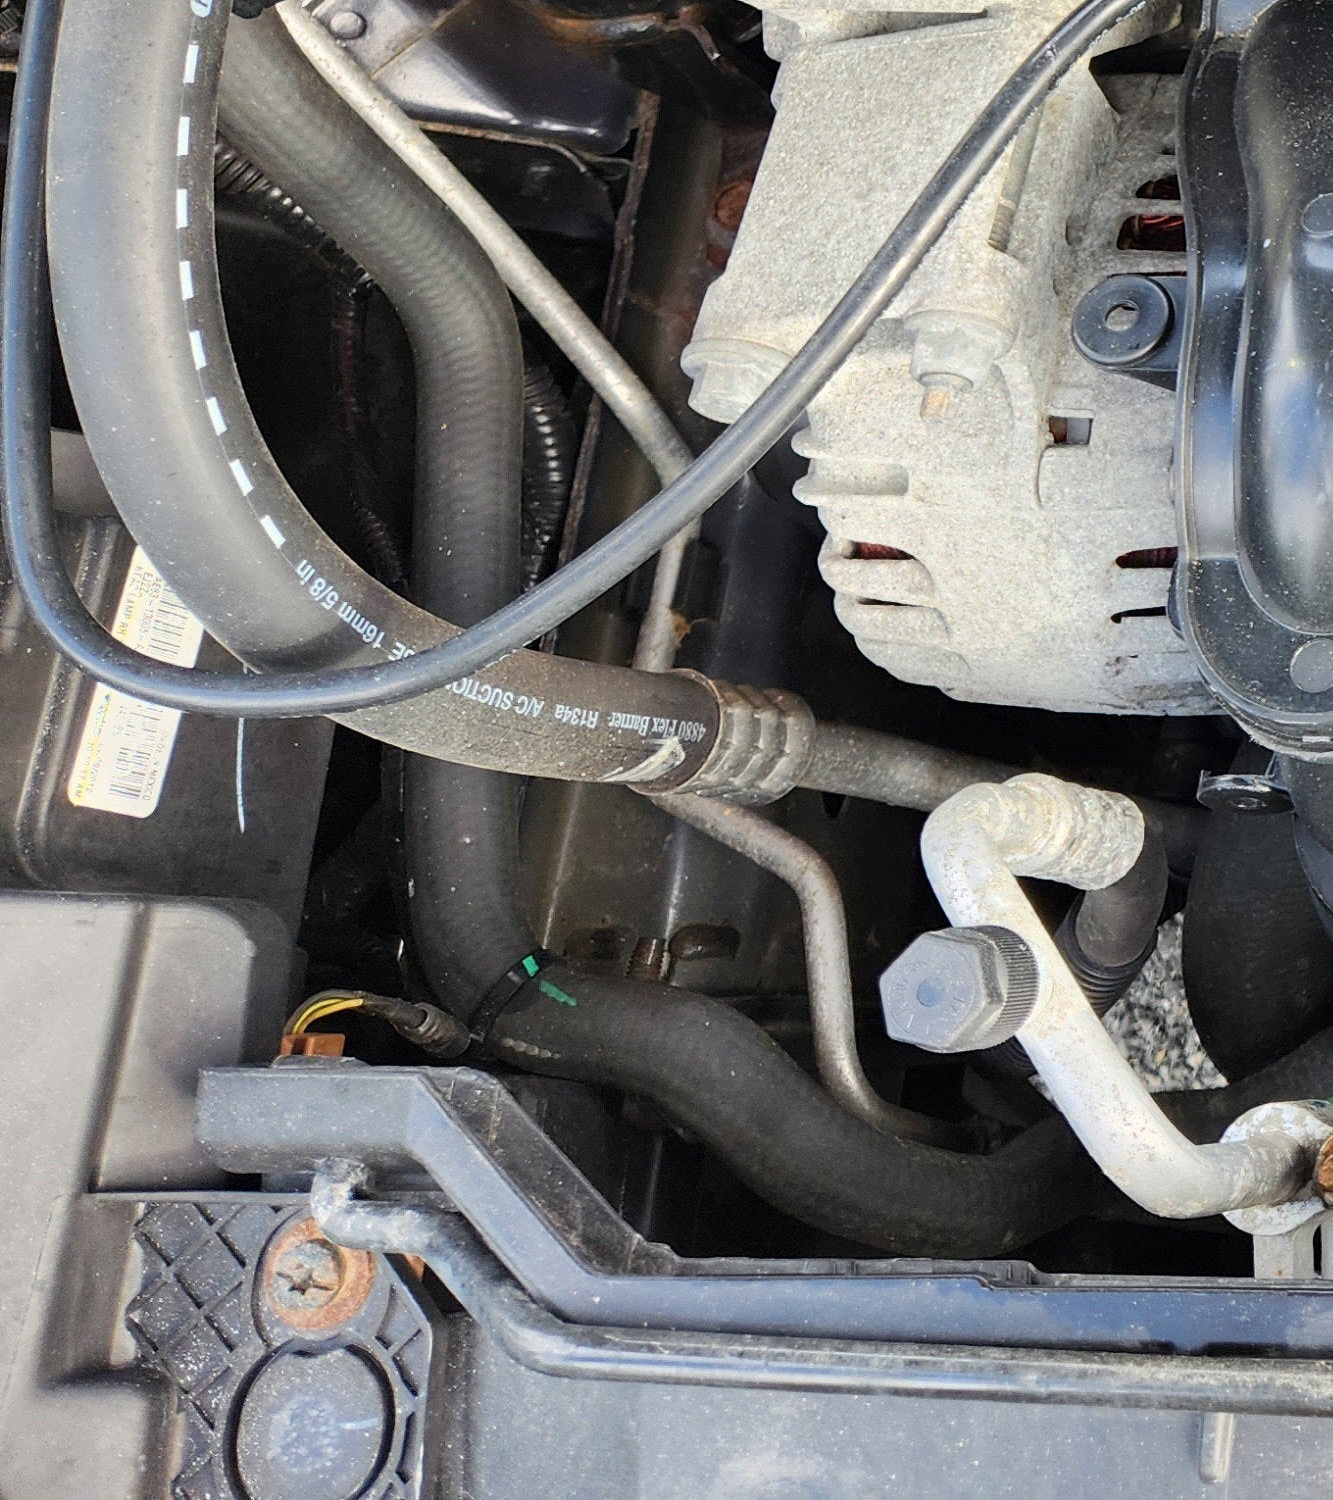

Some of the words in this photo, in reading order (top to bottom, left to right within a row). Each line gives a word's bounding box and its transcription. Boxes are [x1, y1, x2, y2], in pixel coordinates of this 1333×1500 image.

[296, 558, 310, 587] in
[310, 578, 338, 611] 5/8
[338, 601, 385, 650] 16mm
[448, 678, 515, 712] SUCTIO
[514, 697, 546, 719] A/C
[554, 703, 600, 729] R134a
